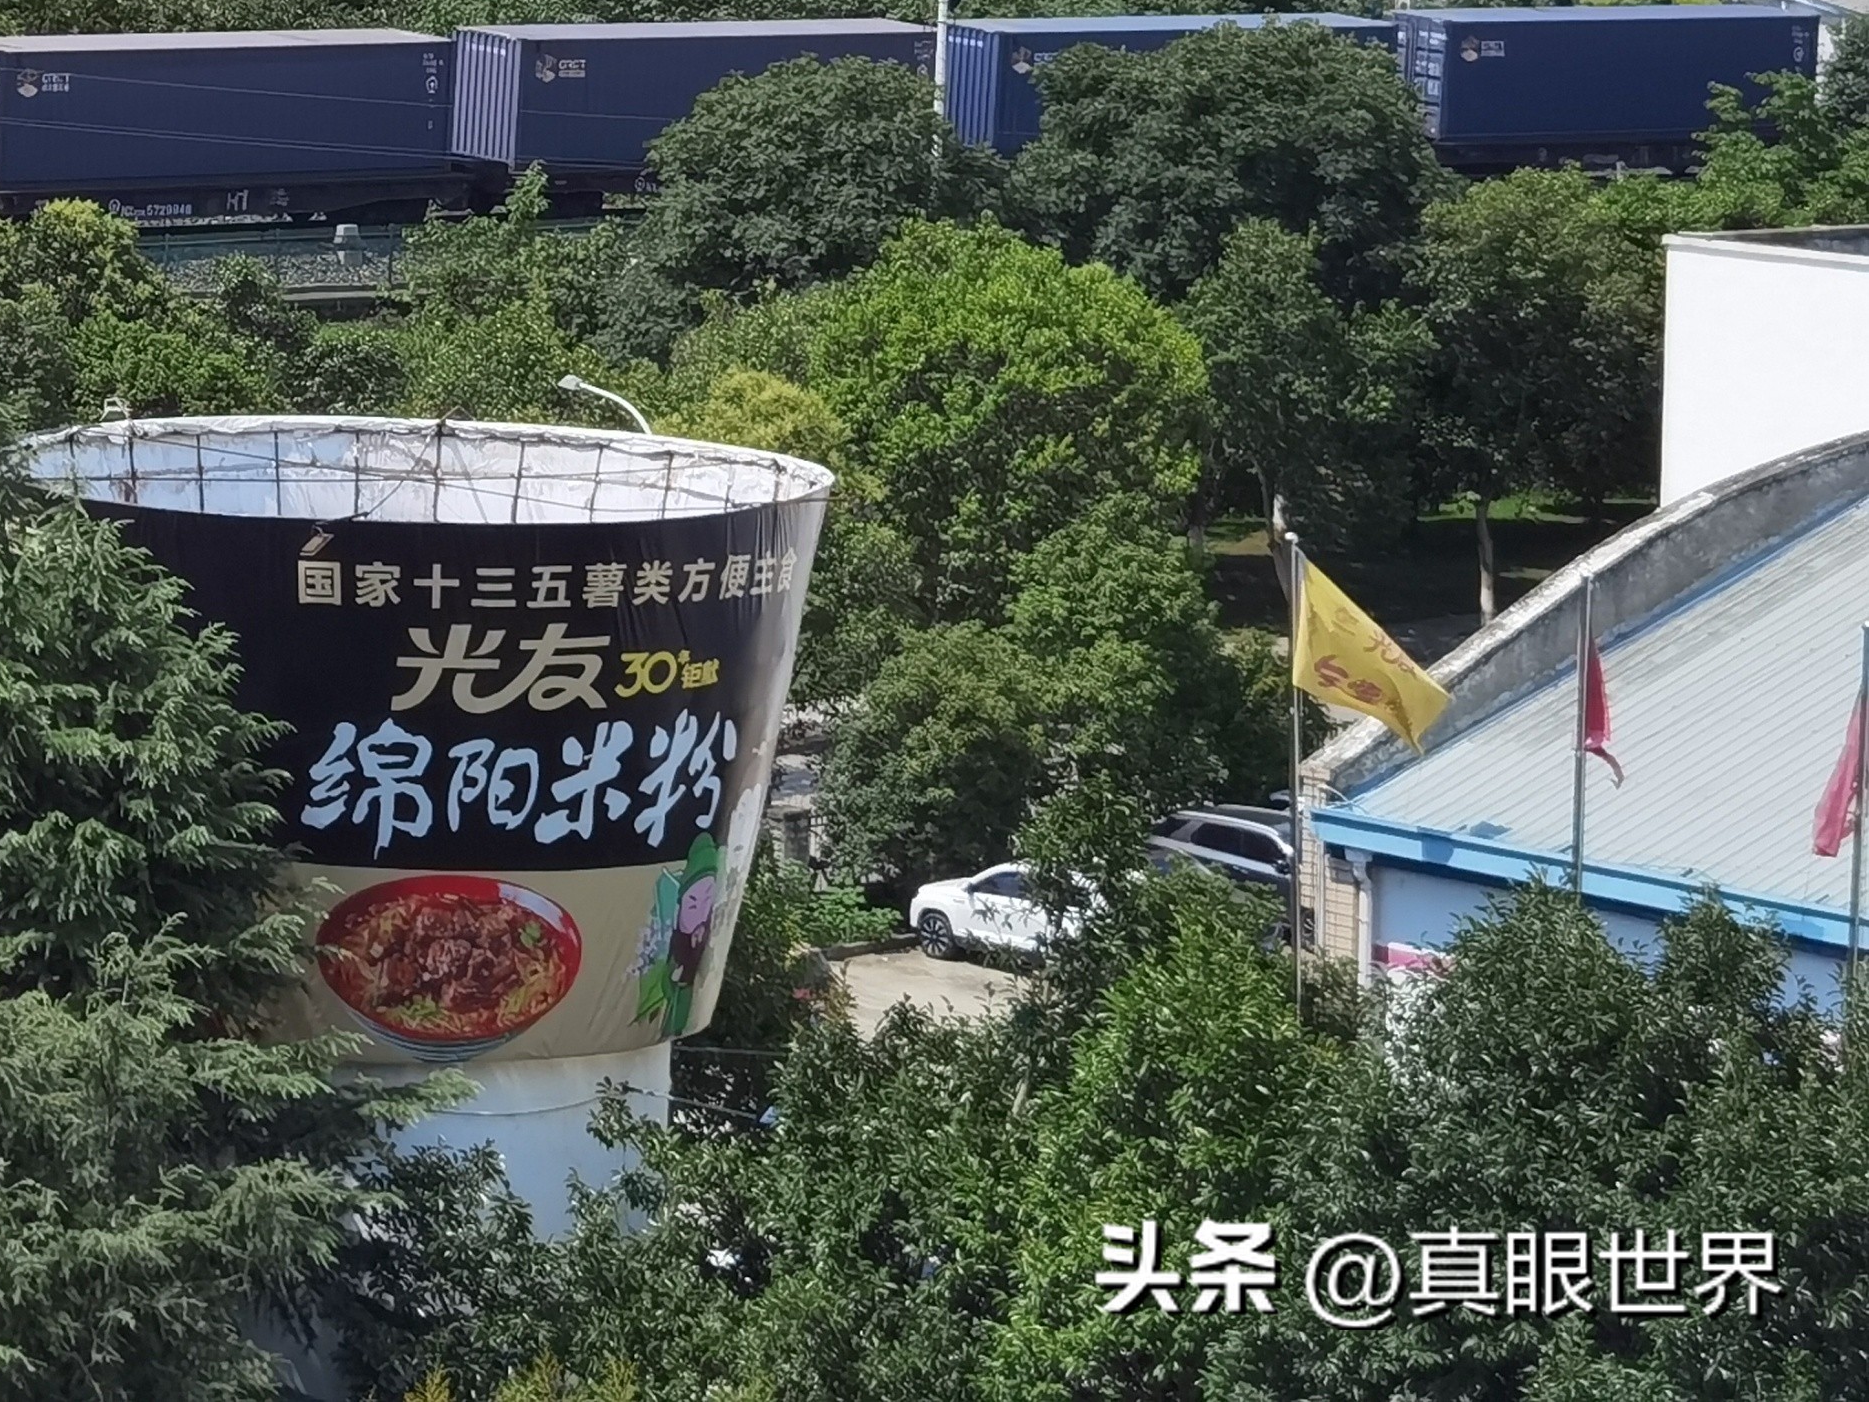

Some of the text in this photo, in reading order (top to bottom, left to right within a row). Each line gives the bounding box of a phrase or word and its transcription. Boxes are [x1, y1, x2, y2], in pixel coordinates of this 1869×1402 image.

[297, 547, 799, 611] 国家十三五薯类方便主食
[390, 622, 610, 712] 光友
[301, 707, 736, 860] 绵阳米粉
